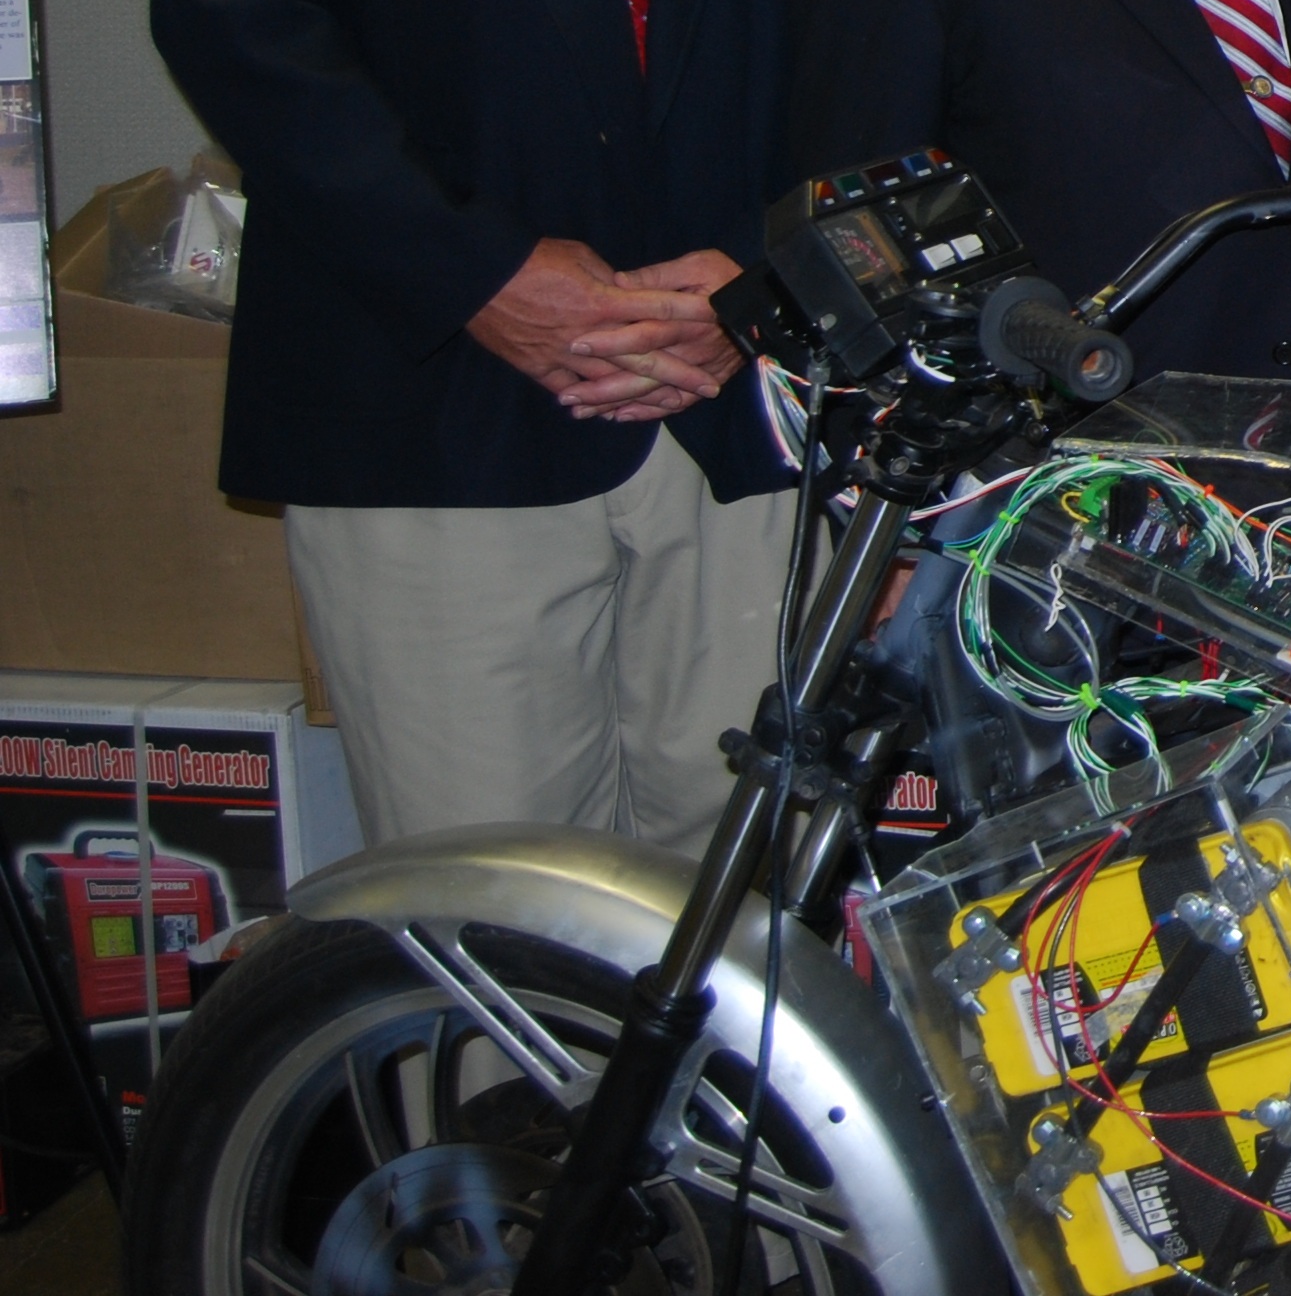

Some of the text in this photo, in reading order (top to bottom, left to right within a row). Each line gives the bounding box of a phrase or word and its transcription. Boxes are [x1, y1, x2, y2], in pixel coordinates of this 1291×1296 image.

[0, 735, 270, 789] 00W Silent Caming Generator
[885, 770, 938, 811] rator
[122, 1106, 142, 1115] Dur
